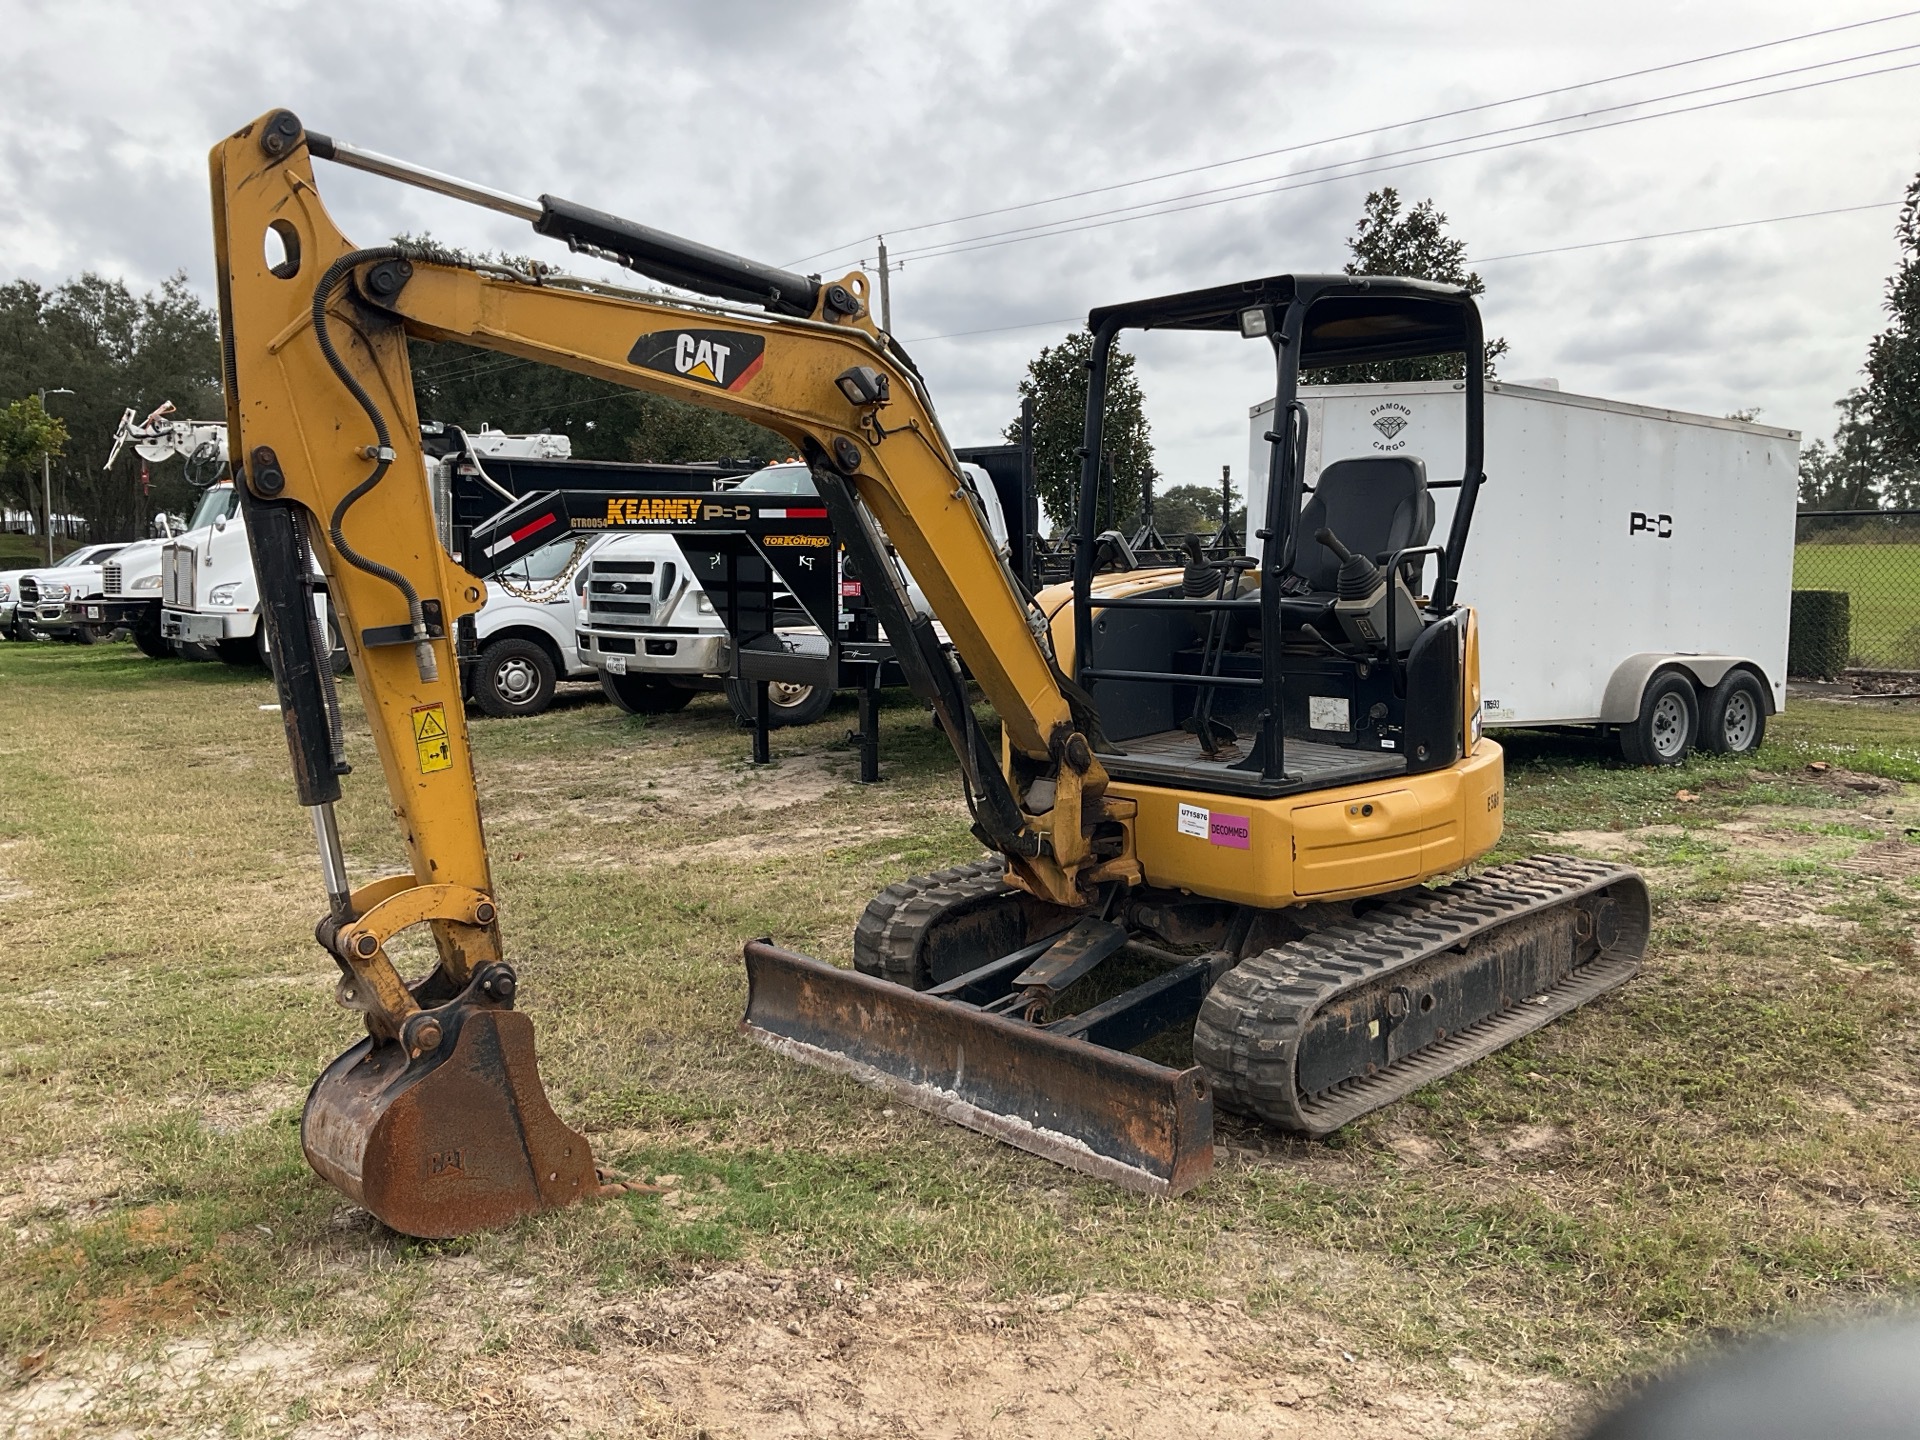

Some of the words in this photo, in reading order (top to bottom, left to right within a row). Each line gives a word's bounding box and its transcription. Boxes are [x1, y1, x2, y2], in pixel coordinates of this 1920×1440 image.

[674, 332, 731, 384] CAT
[1370, 402, 1412, 416] DIAMOND
[1372, 440, 1406, 451] CARGO
[607, 499, 702, 525] KEARNEY
[1181, 809, 1208, 821] U715876
[1211, 823, 1248, 839] DECOMMED
